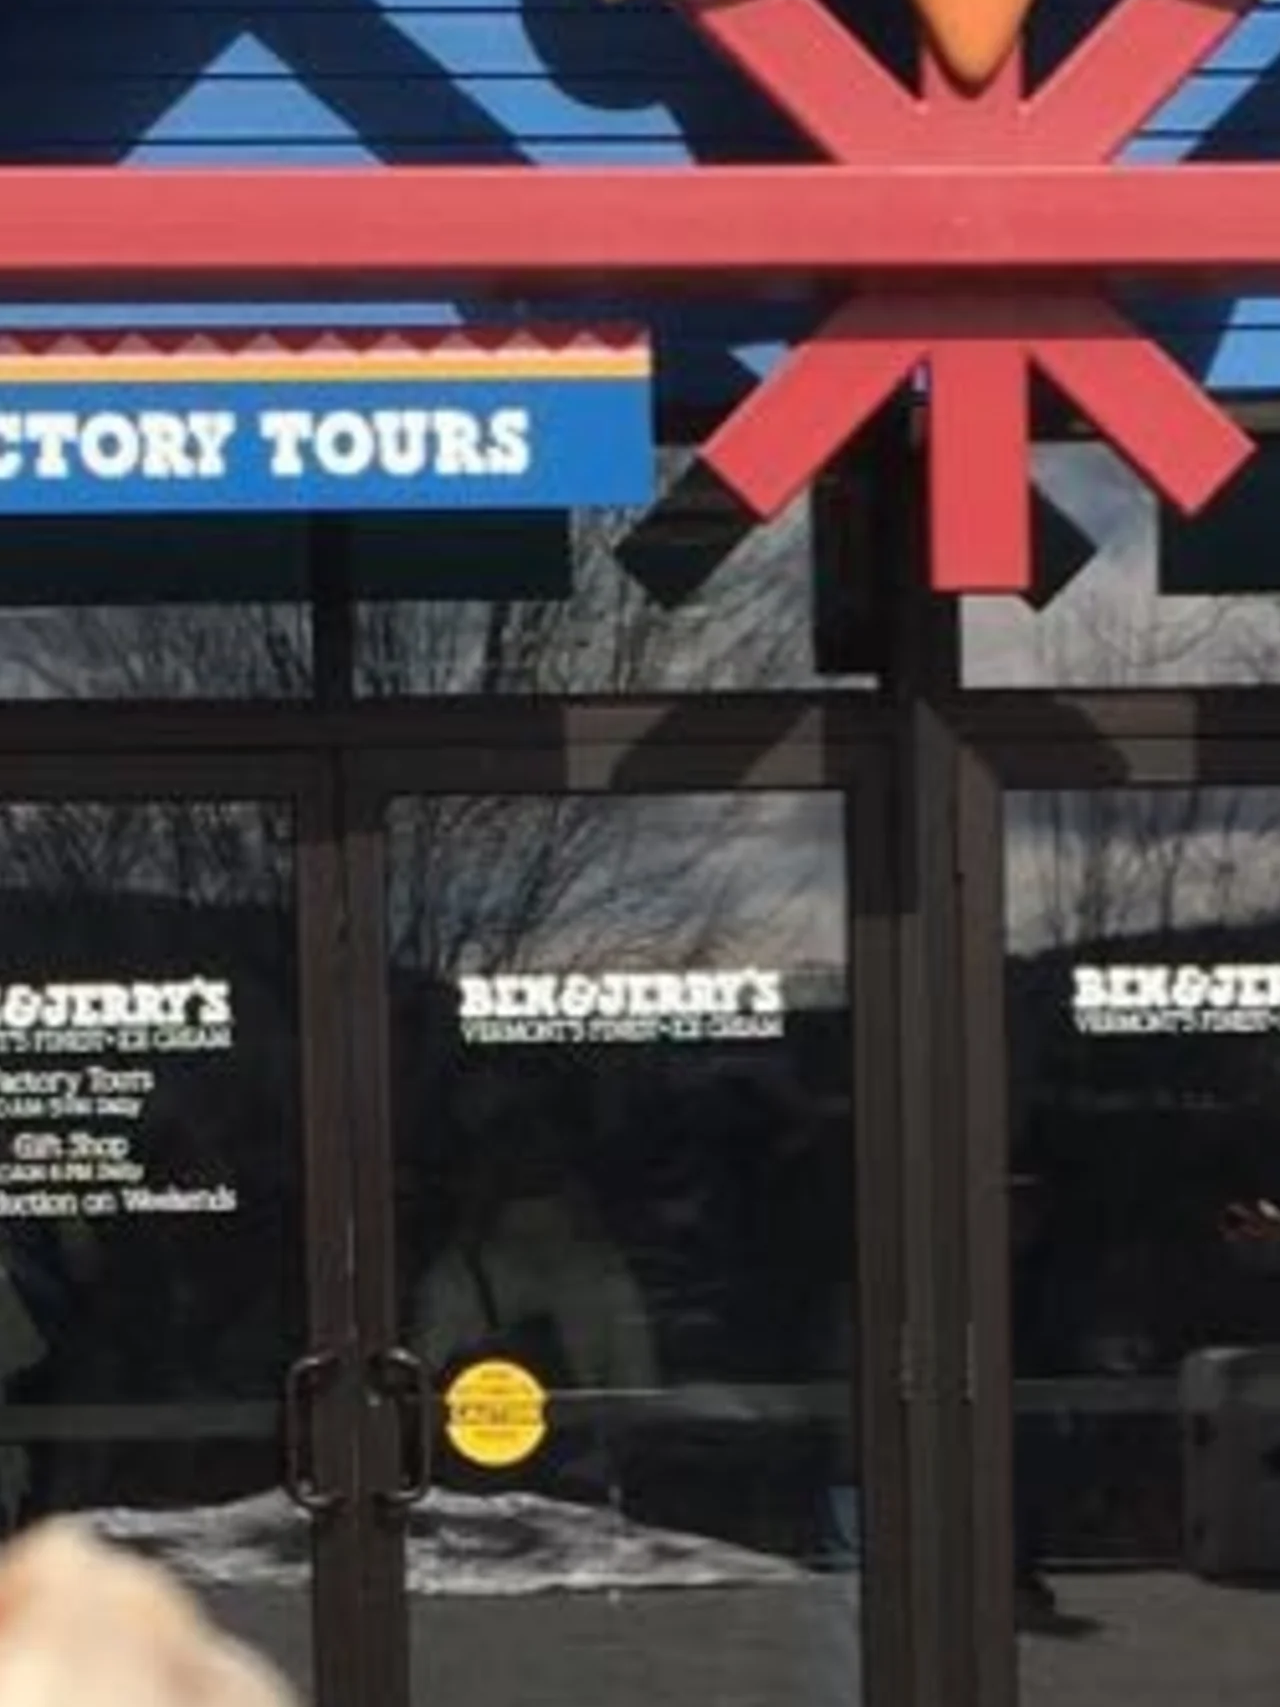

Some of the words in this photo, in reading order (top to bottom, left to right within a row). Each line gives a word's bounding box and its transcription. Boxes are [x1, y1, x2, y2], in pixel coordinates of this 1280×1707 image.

[261, 410, 530, 475] TOURS
[82, 1192, 117, 1215] on
[122, 1186, 237, 1212] Weekends
